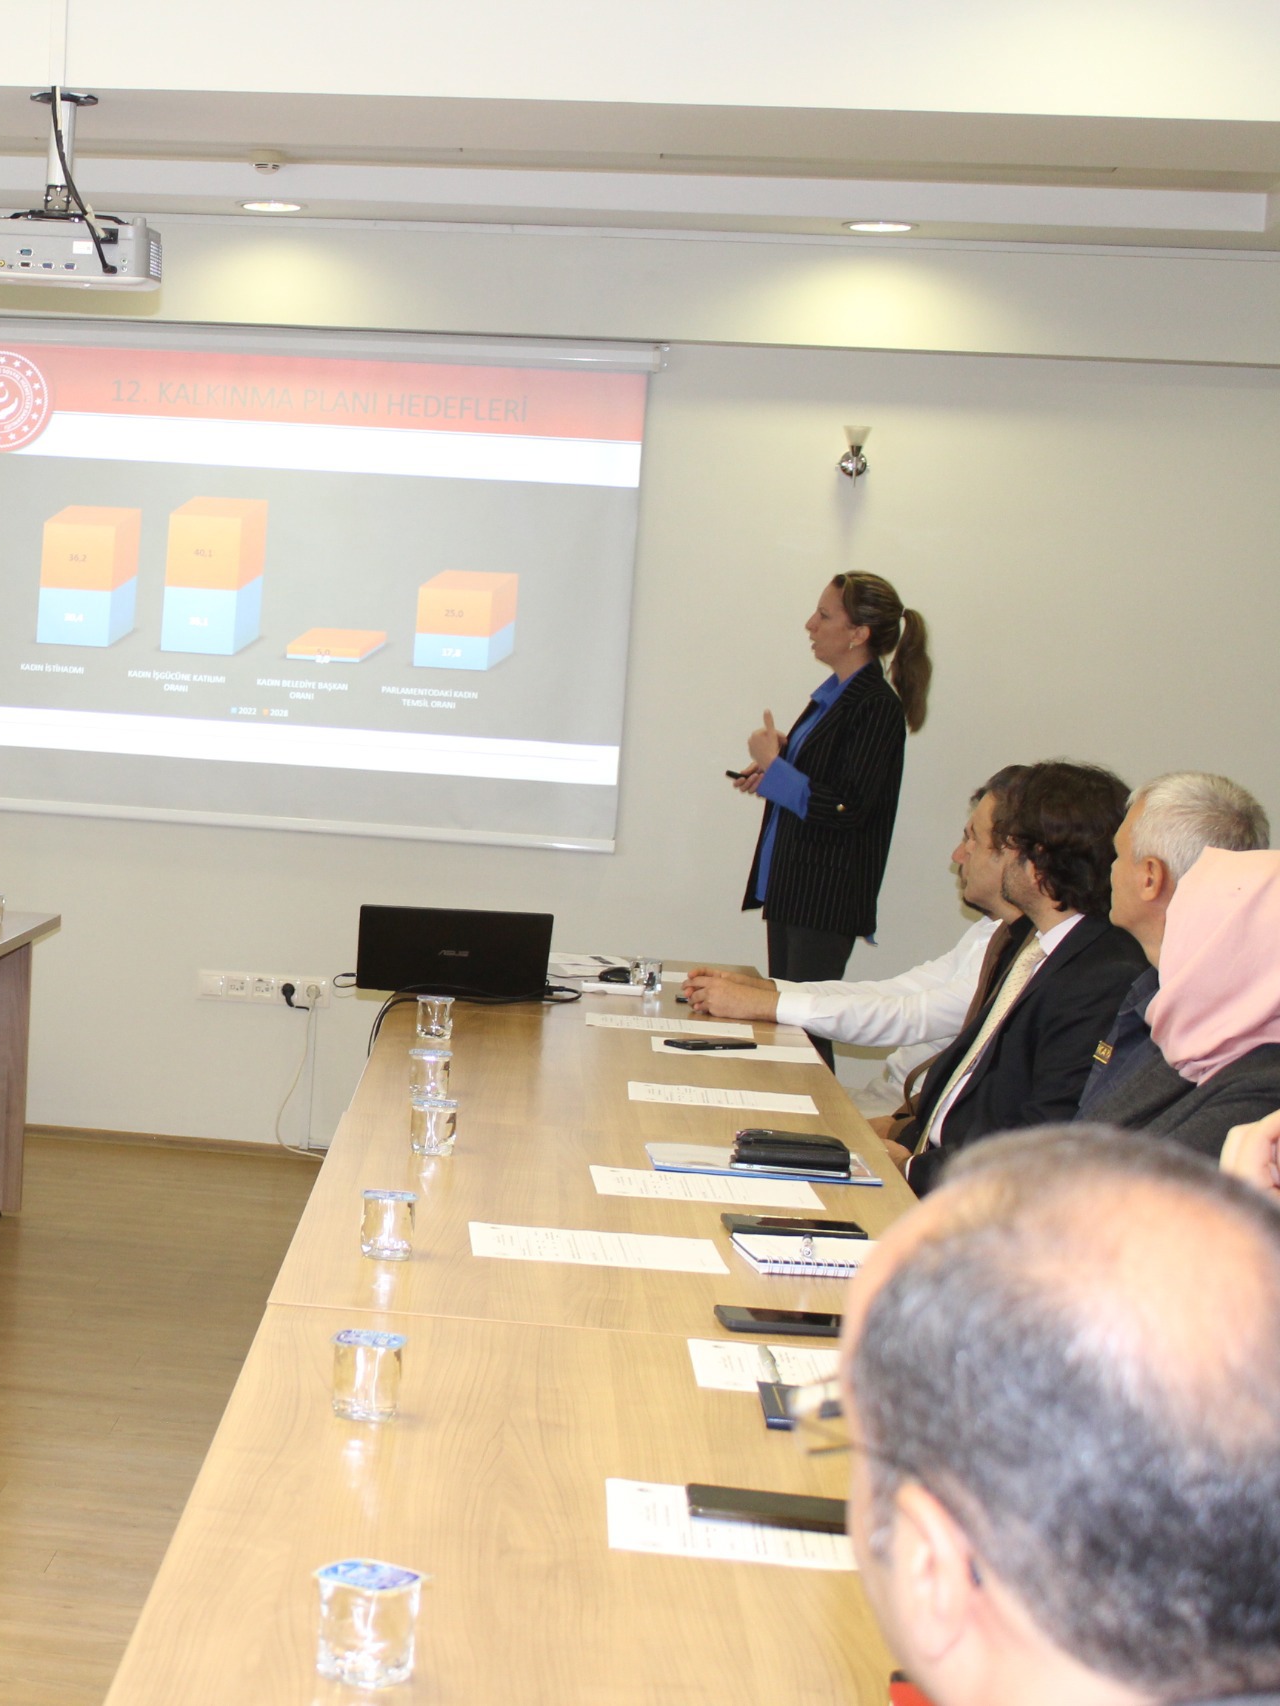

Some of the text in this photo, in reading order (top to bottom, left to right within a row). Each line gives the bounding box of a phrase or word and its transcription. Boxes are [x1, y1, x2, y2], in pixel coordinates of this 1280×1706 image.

[111, 379, 529, 423] 12. KALKINMA PLANI HEDEFLERİ
[20, 663, 44, 672] KADIN
[128, 670, 226, 684] KADIN İŞGÜCÜNE KATILIMI
[163, 684, 188, 692] ORANI
[257, 678, 349, 691] KADIN BELEDİYE BAŞKAN
[289, 691, 314, 700] ORANI
[381, 686, 479, 699] PARLAMENTODAKİ KADIN
[401, 698, 456, 709] TEMSİL ORANI
[238, 706, 257, 715] 2022
